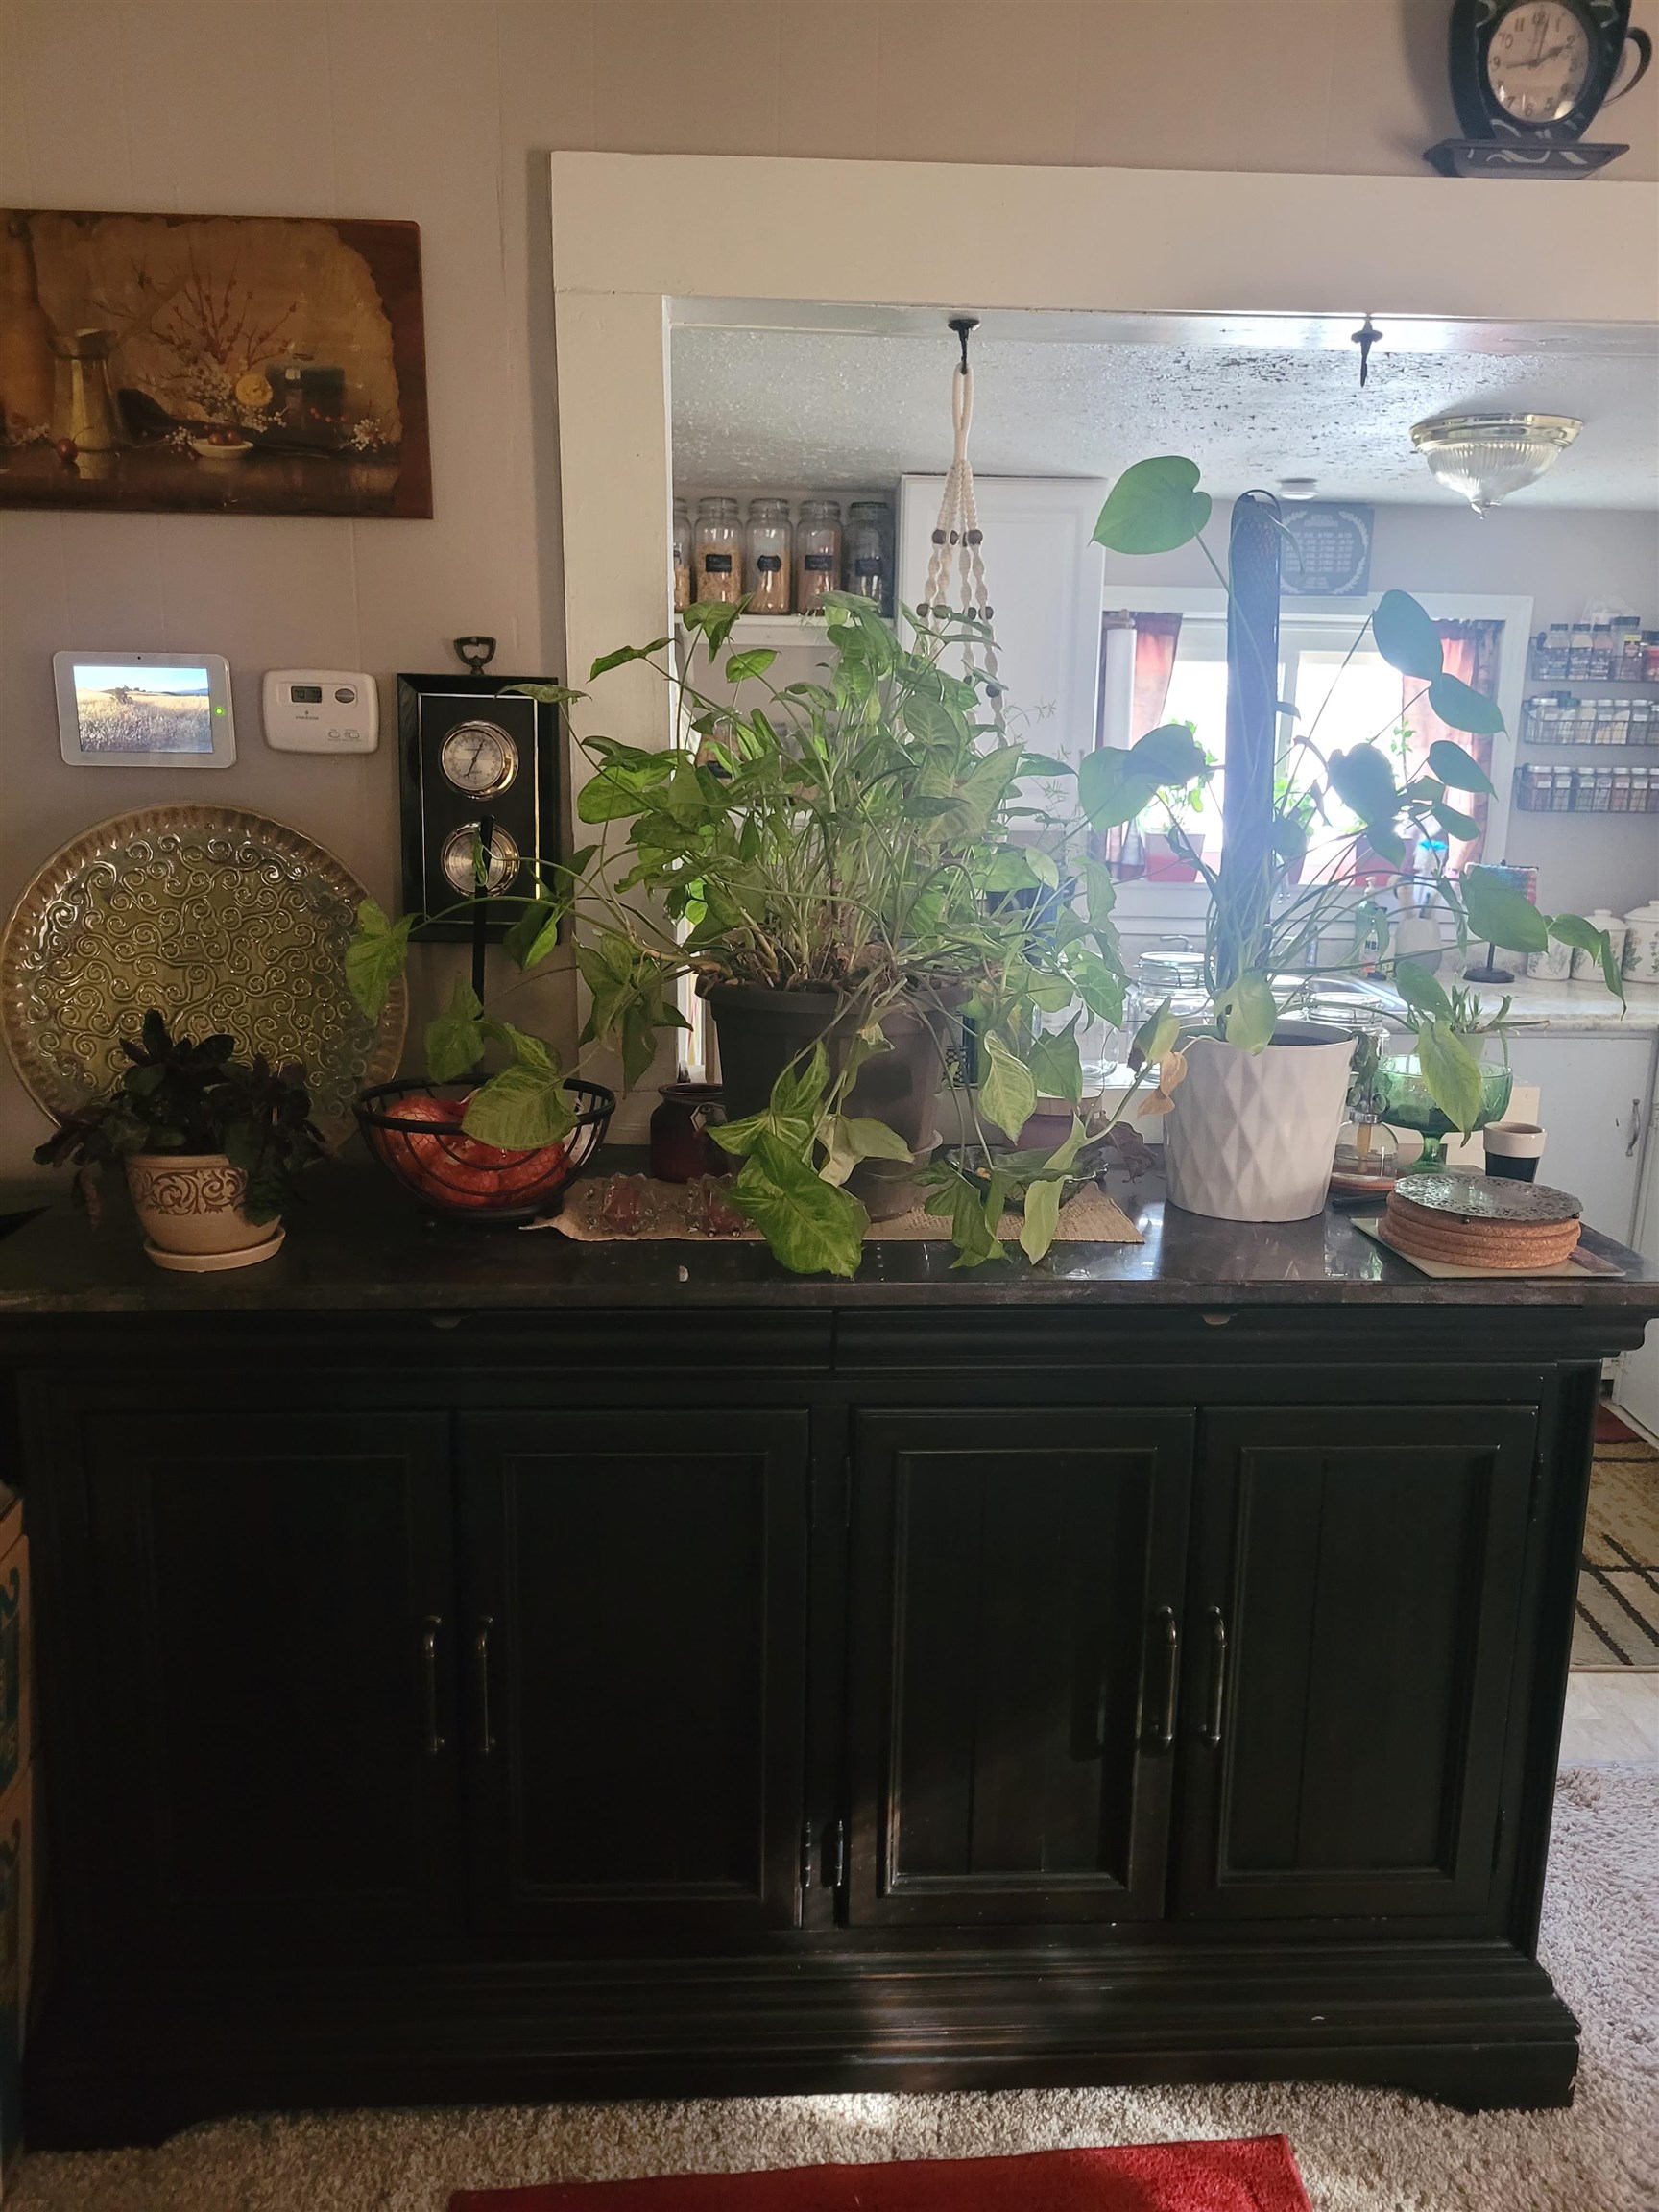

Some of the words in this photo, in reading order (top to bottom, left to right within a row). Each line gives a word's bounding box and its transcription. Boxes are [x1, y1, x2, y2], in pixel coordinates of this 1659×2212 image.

[1515, 17, 1525, 32] 11
[1555, 17, 1561, 32] 1
[1499, 32, 1513, 49] 10
[1491, 56, 1501, 72] 9
[1507, 95, 1516, 109] 7
[1525, 103, 1534, 116] 6
[1543, 96, 1553, 111] 5
